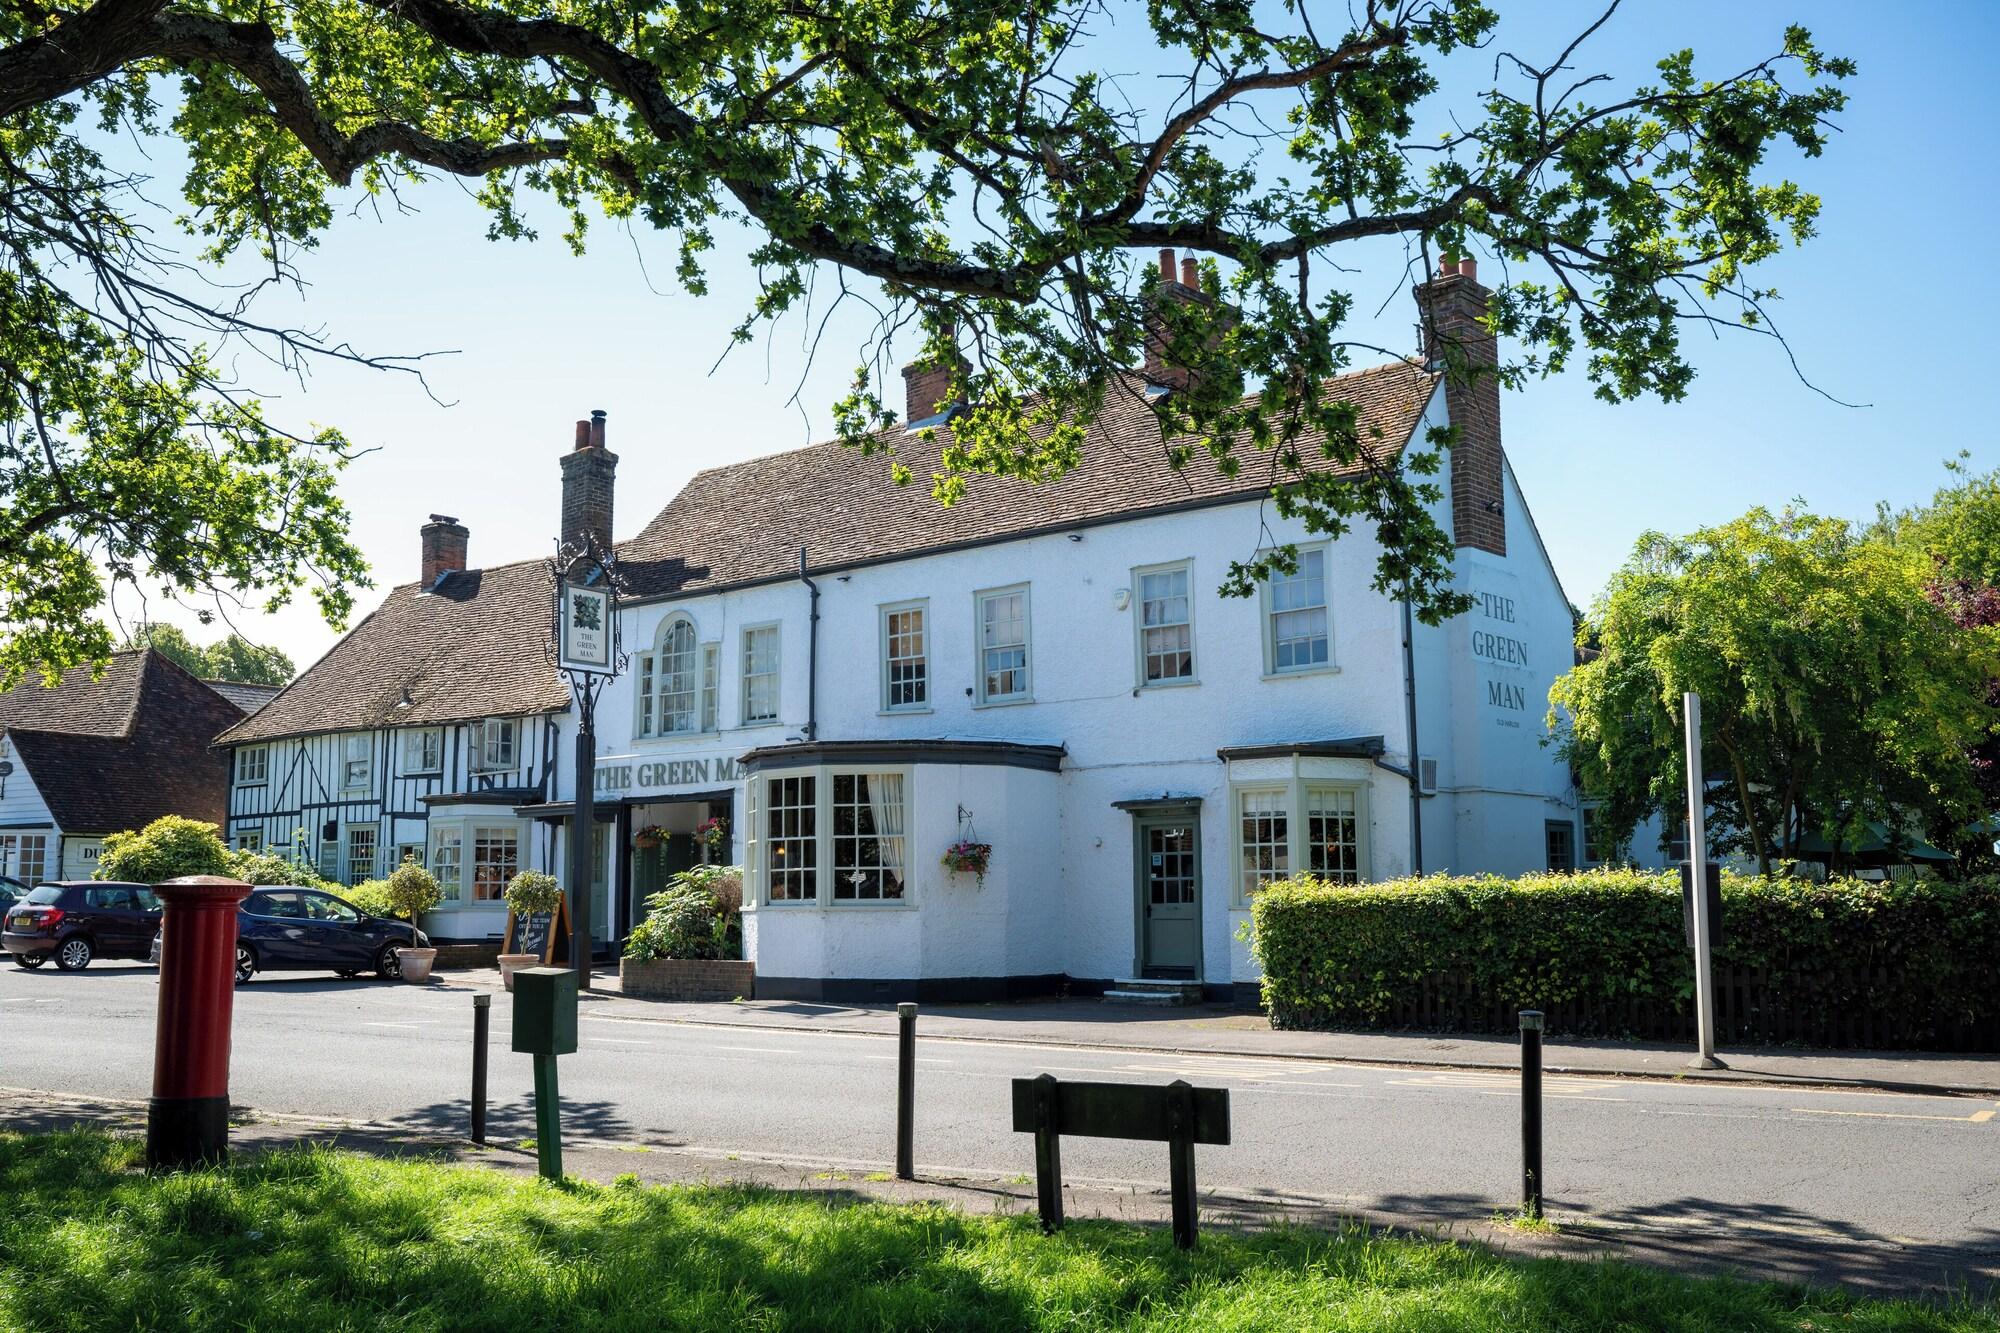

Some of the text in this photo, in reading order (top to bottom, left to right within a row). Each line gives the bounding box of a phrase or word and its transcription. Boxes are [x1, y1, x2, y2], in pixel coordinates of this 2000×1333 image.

[1481, 592, 1515, 624] THE
[577, 641, 597, 650] GREEN
[581, 633, 593, 641] THE
[1472, 630, 1528, 666] GREEN
[1488, 680, 1525, 711] MAN
[594, 756, 746, 791] THE GREEN MA
